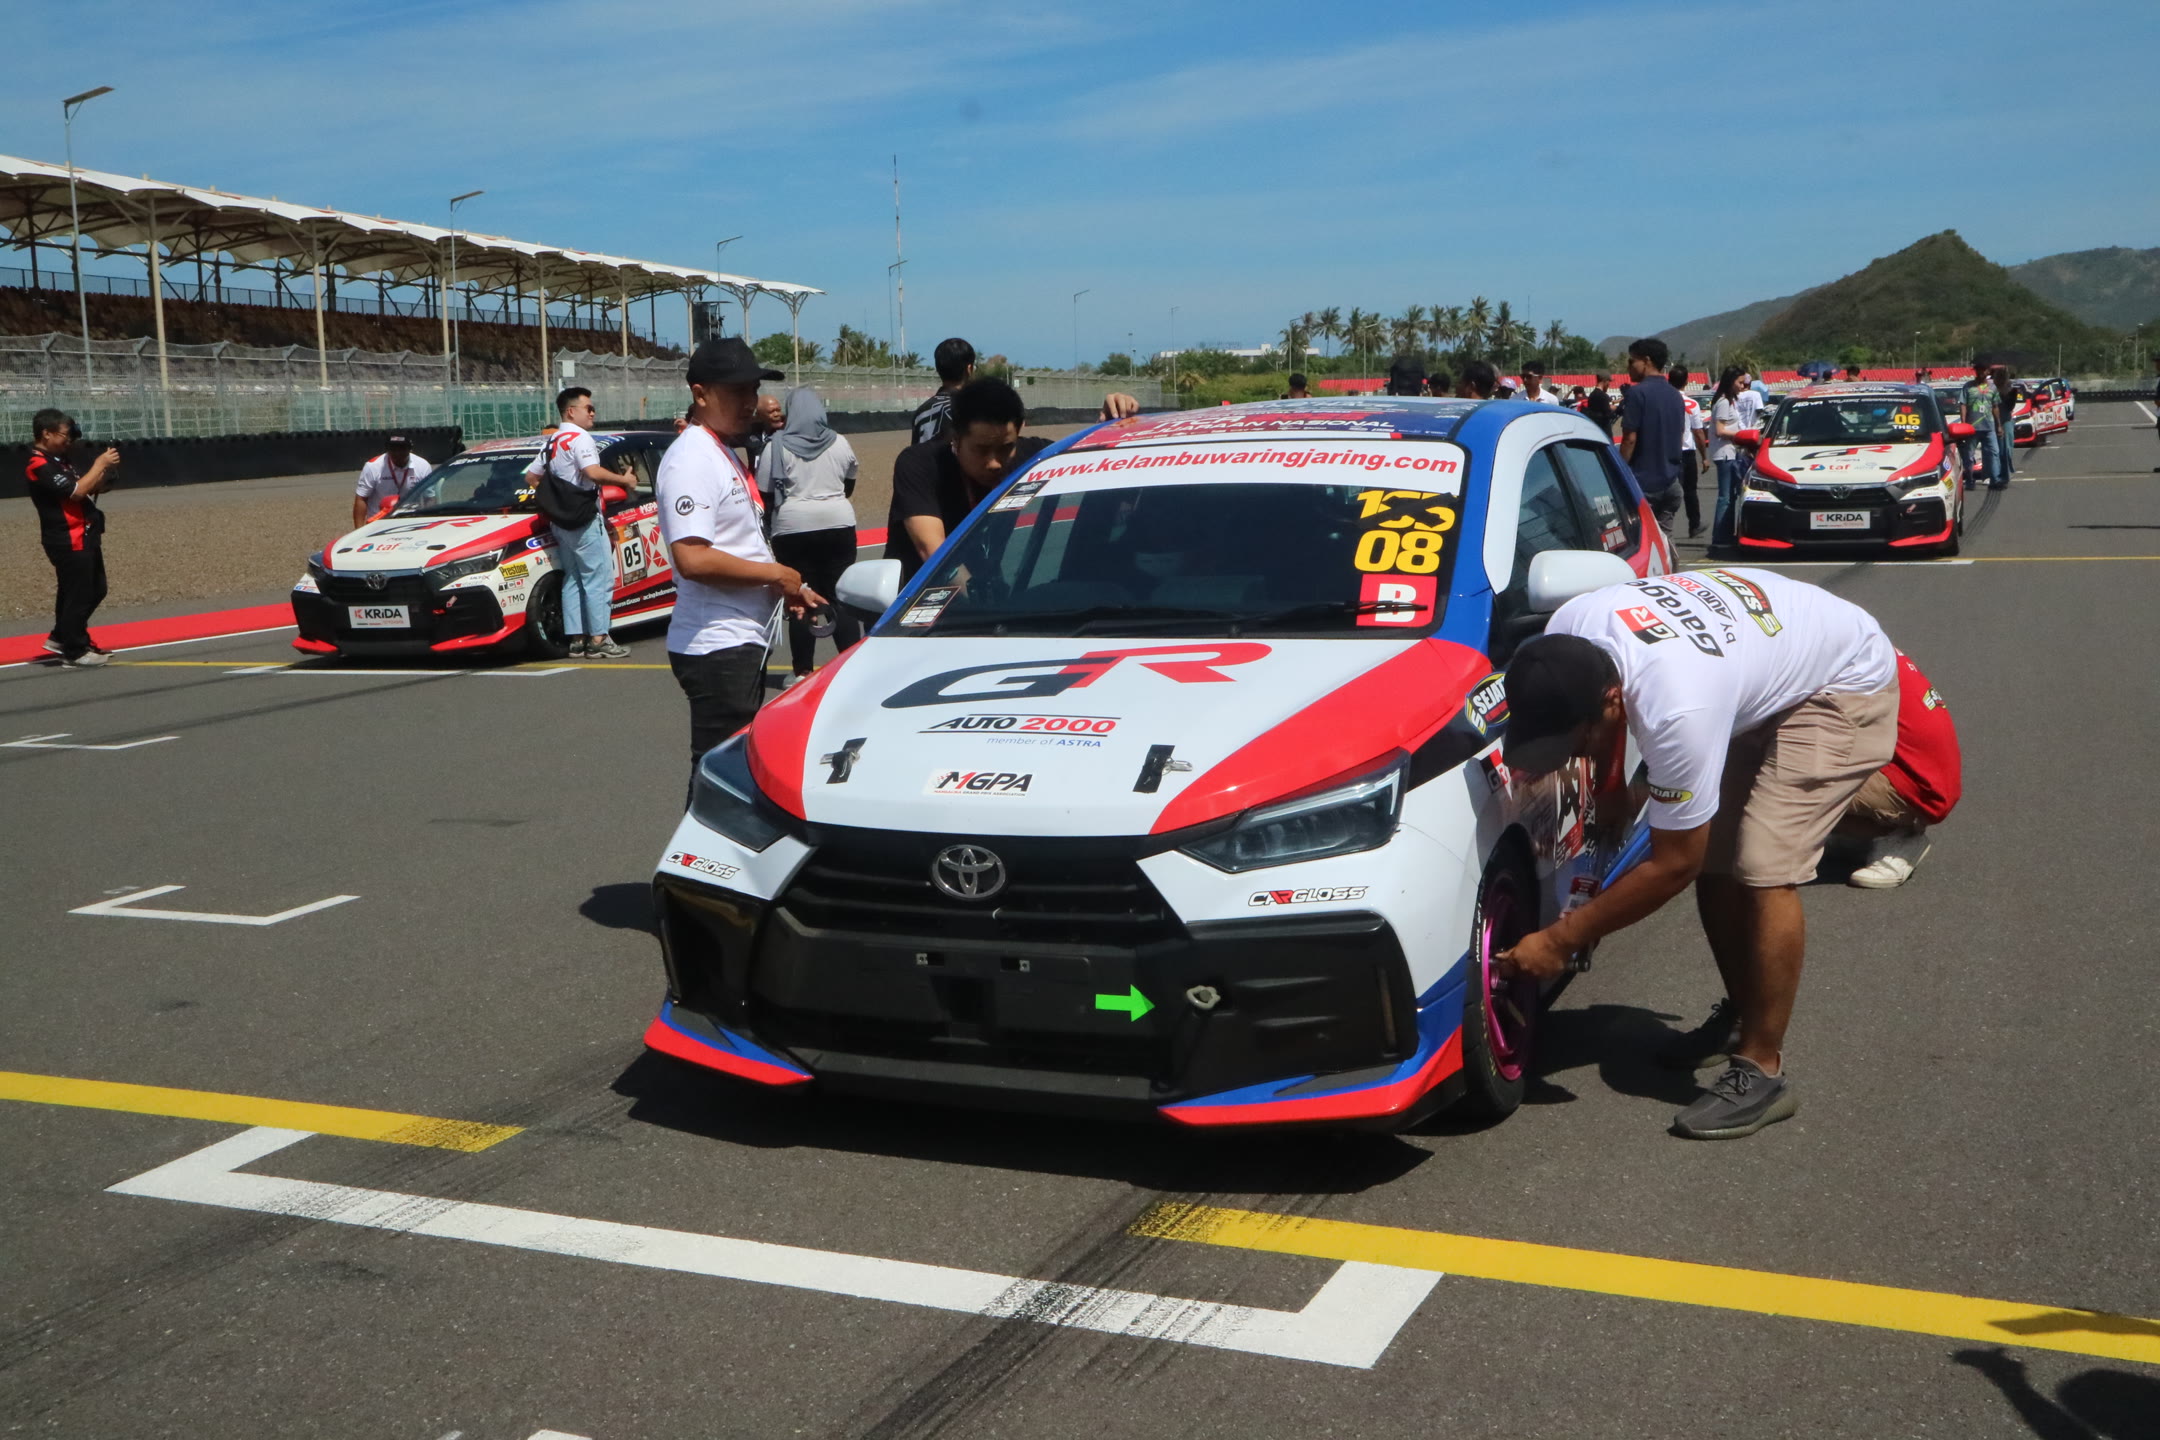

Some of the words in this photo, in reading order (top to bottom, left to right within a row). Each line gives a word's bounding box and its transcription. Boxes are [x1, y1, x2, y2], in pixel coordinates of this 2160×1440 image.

[1121, 420, 1266, 437] KEJUARAAN
[1269, 419, 1396, 428] NASIONAL
[1894, 414, 1921, 425] 06
[1801, 445, 1894, 460] GR
[1027, 448, 1458, 482] www.kelambuwaringjaring.com
[367, 516, 489, 538] GR
[376, 542, 402, 551] taf
[623, 543, 642, 567] 05
[1354, 530, 1443, 574] 08
[501, 563, 528, 577] Prestone
[364, 608, 403, 619] KRiDA
[1375, 583, 1417, 622] B
[1697, 590, 1732, 620] AUTO
[1625, 580, 1725, 657] Garage
[1630, 606, 1676, 639] GR
[1720, 622, 1737, 644] by
[881, 643, 1272, 708] GR
[1473, 676, 1507, 715] SEJAT
[928, 717, 1017, 730] AUTO
[1019, 718, 1117, 733] 2000
[987, 737, 1037, 746] member
[1040, 737, 1055, 746] of
[1057, 738, 1102, 748] ASTRA
[935, 771, 1033, 792] MGPA
[666, 851, 741, 880] CARGLOSS
[1248, 885, 1370, 907] CARGLOSS
